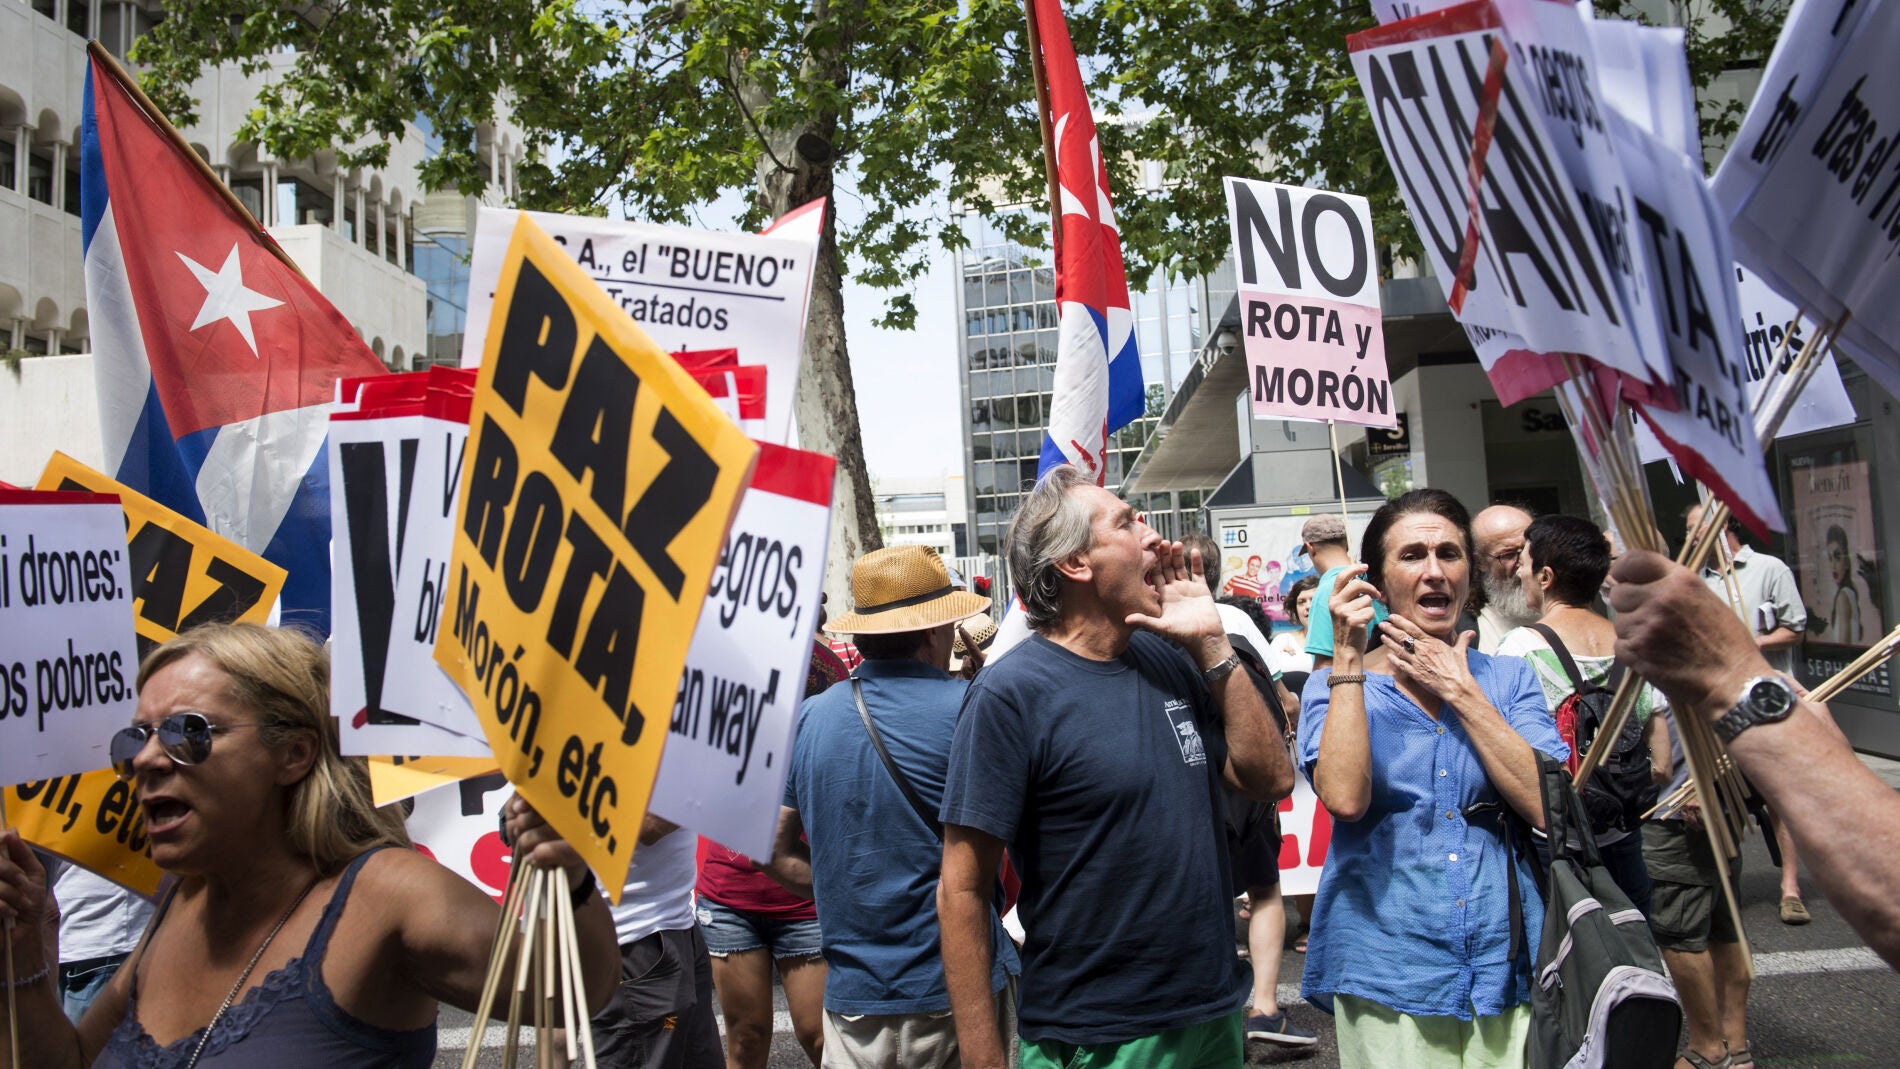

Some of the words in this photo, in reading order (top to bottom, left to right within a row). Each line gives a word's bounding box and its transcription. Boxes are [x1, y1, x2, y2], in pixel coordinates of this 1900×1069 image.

[1811, 74, 1876, 184] tras
[622, 244, 648, 274] el
[658, 245, 796, 288] "BUENO"
[1232, 180, 1368, 298] NO
[1247, 300, 1345, 346] ROTA
[1355, 323, 1372, 360] y
[492, 255, 720, 604] PAZ
[1255, 365, 1388, 416] MORÓN
[1676, 366, 1745, 455] TAR!
[19, 534, 123, 607] drones:
[463, 411, 646, 746] ROTA,
[1224, 529, 1248, 544] #0
[708, 532, 802, 639] egros,
[36, 638, 132, 732] pobres.
[453, 561, 545, 778] Morón,
[557, 734, 618, 856] etc.
[1808, 658, 1878, 685] SEPHA
